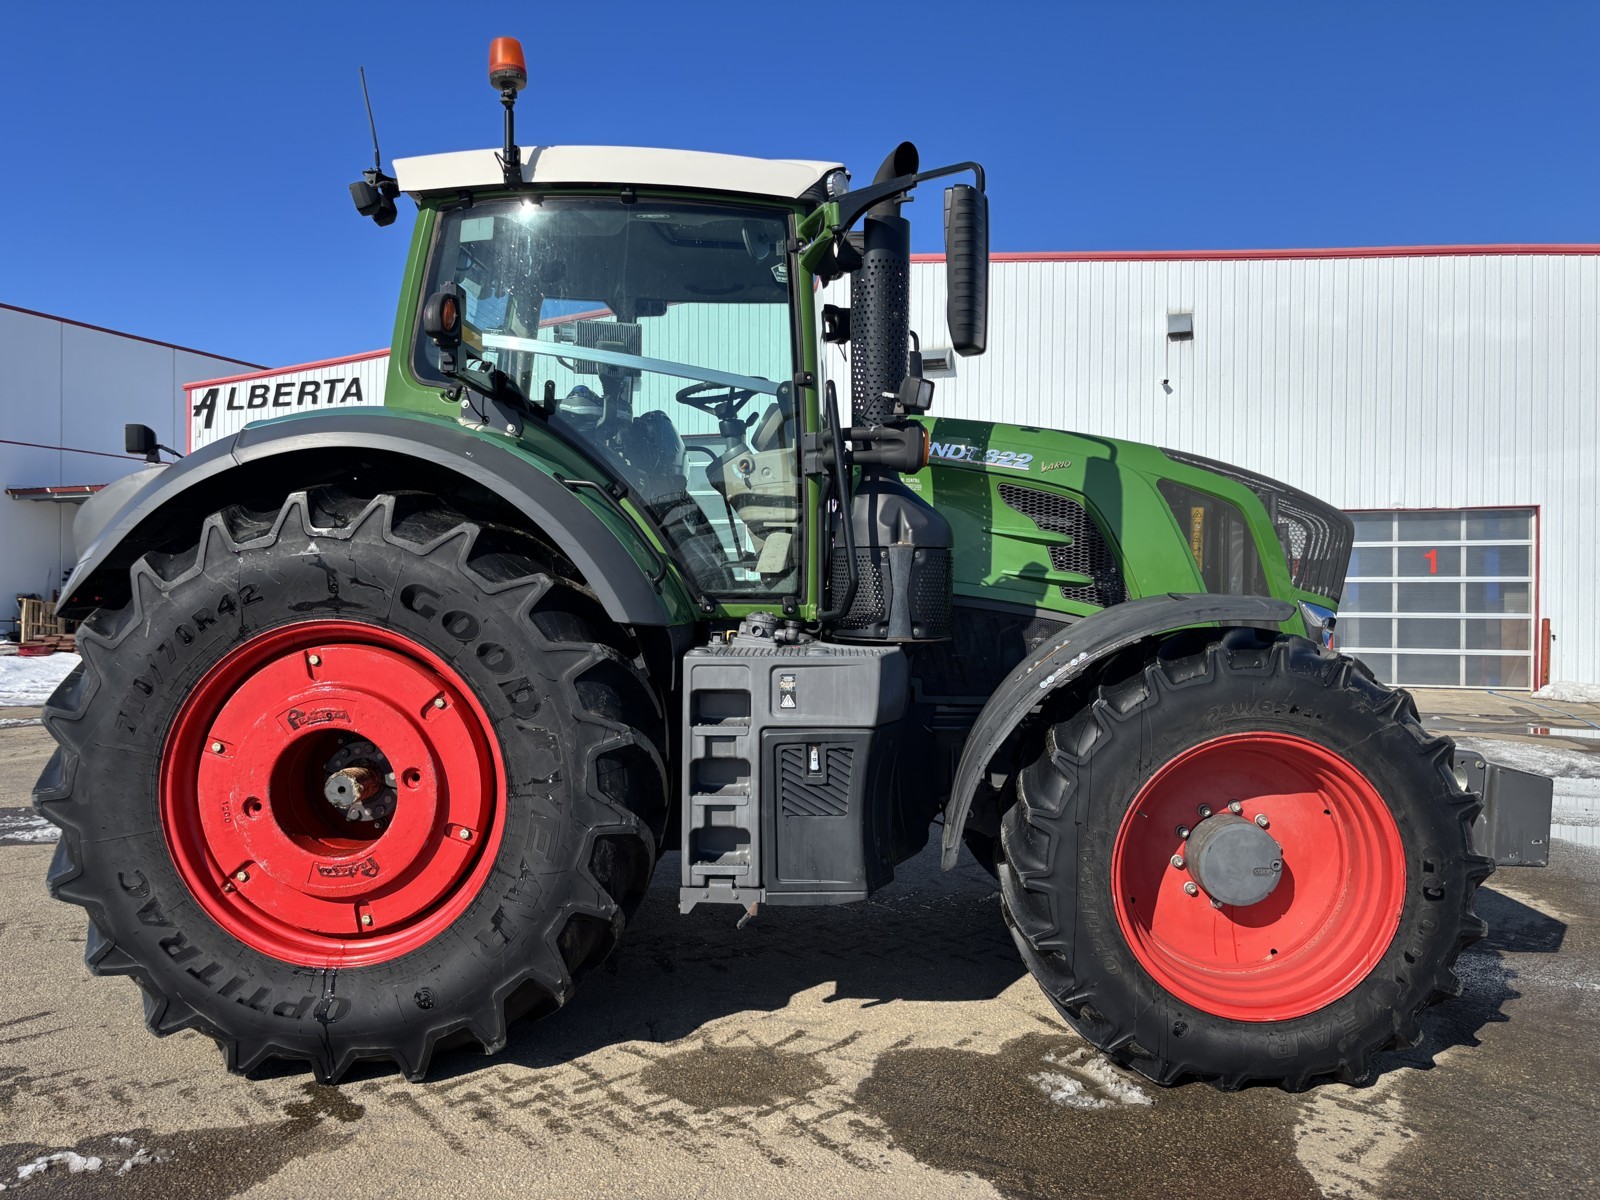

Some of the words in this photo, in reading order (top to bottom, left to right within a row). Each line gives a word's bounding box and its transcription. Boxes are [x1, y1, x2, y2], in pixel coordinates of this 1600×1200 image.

[193, 377, 363, 429] ALBERTA
[929, 442, 981, 461] NDT
[983, 448, 1034, 469] 822
[1423, 548, 1438, 574] 1
[1078, 828, 1121, 976] OPTITRAC
[118, 869, 352, 1024] OPTITRAC
